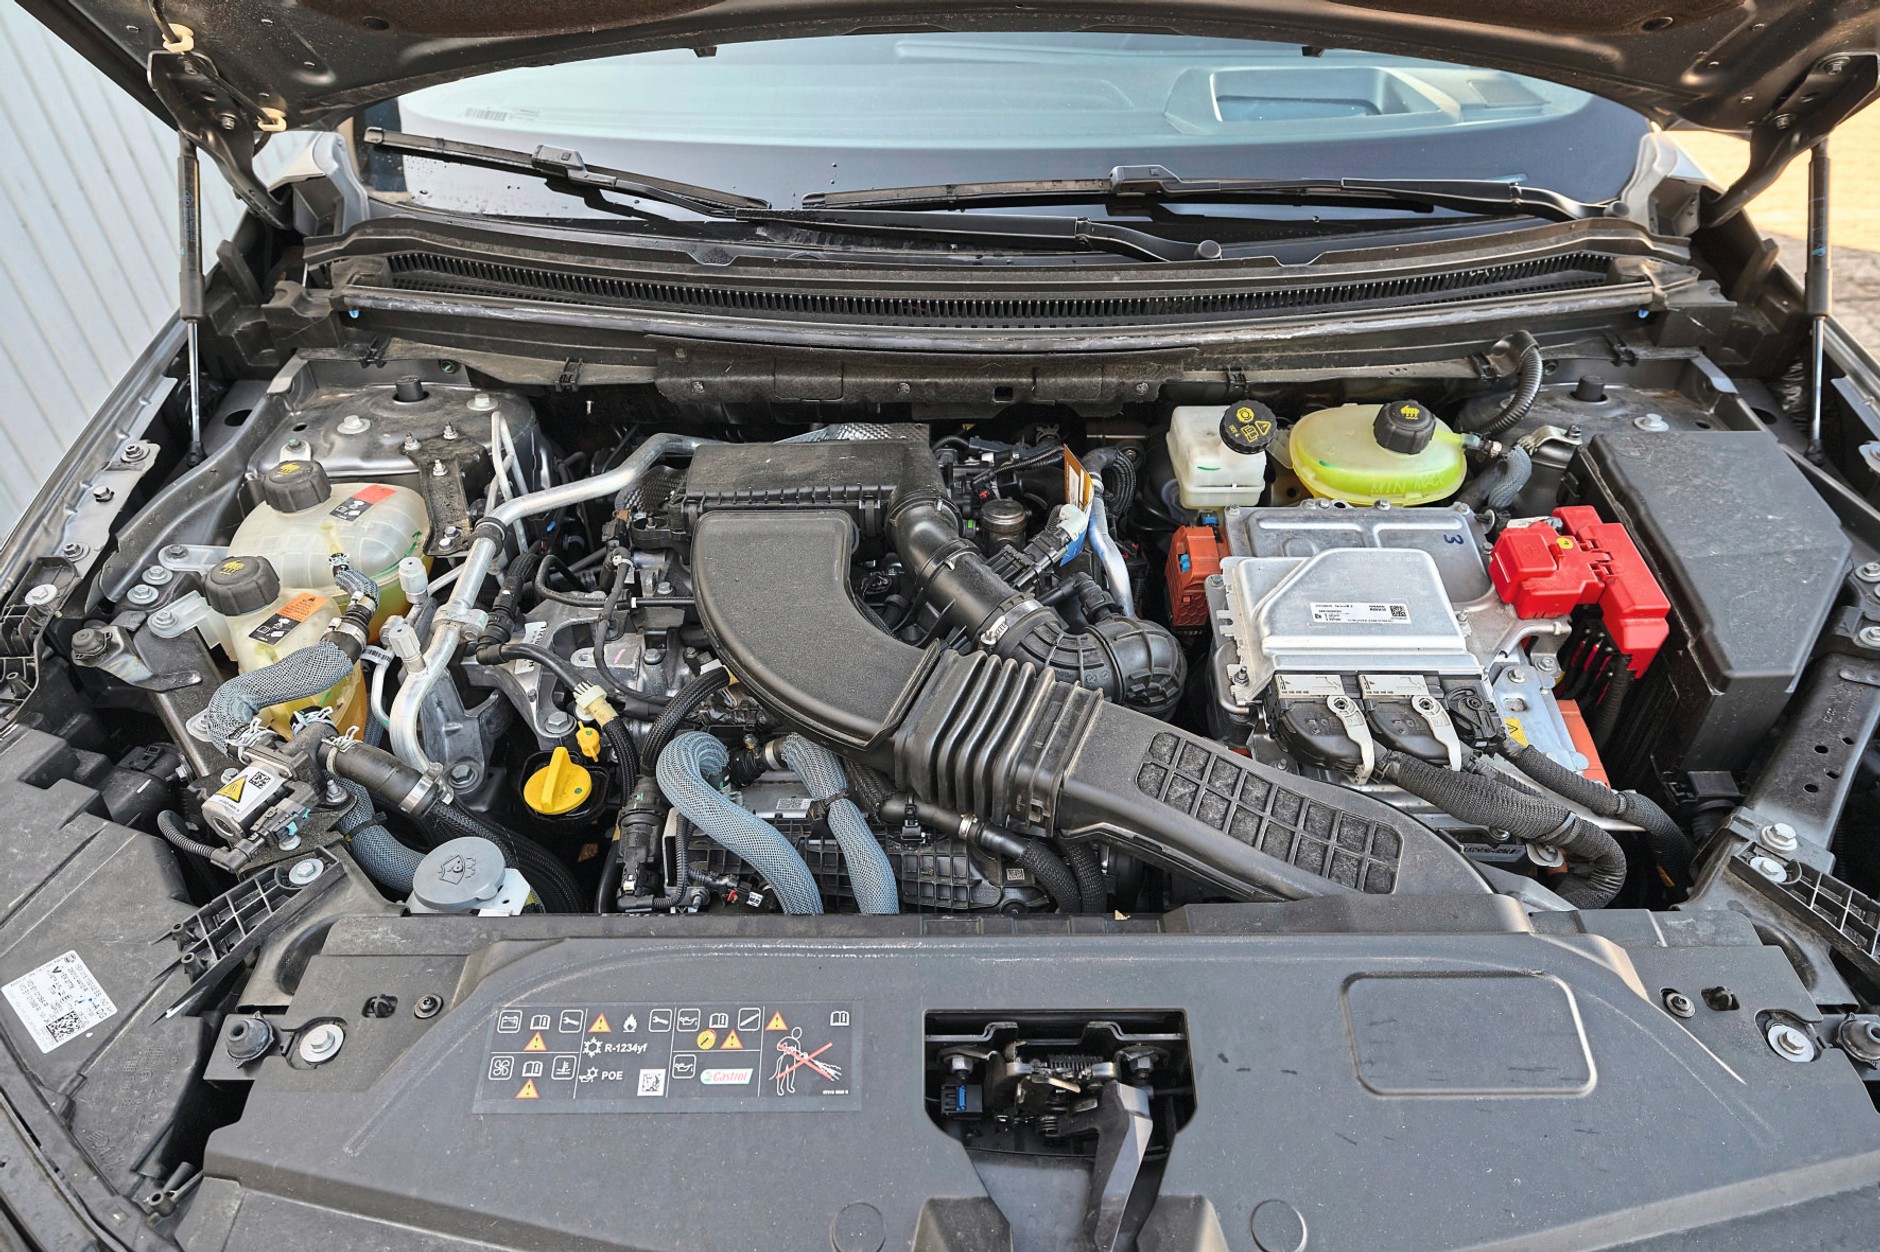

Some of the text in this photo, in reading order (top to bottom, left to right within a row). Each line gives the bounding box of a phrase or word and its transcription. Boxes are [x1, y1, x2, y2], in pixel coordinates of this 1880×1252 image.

[1371, 479, 1406, 494] MIN
[1443, 534, 1464, 545] 3
[604, 1043, 649, 1055] R-1234yf
[601, 1070, 624, 1081] POE
[712, 1071, 748, 1083] Castrol
